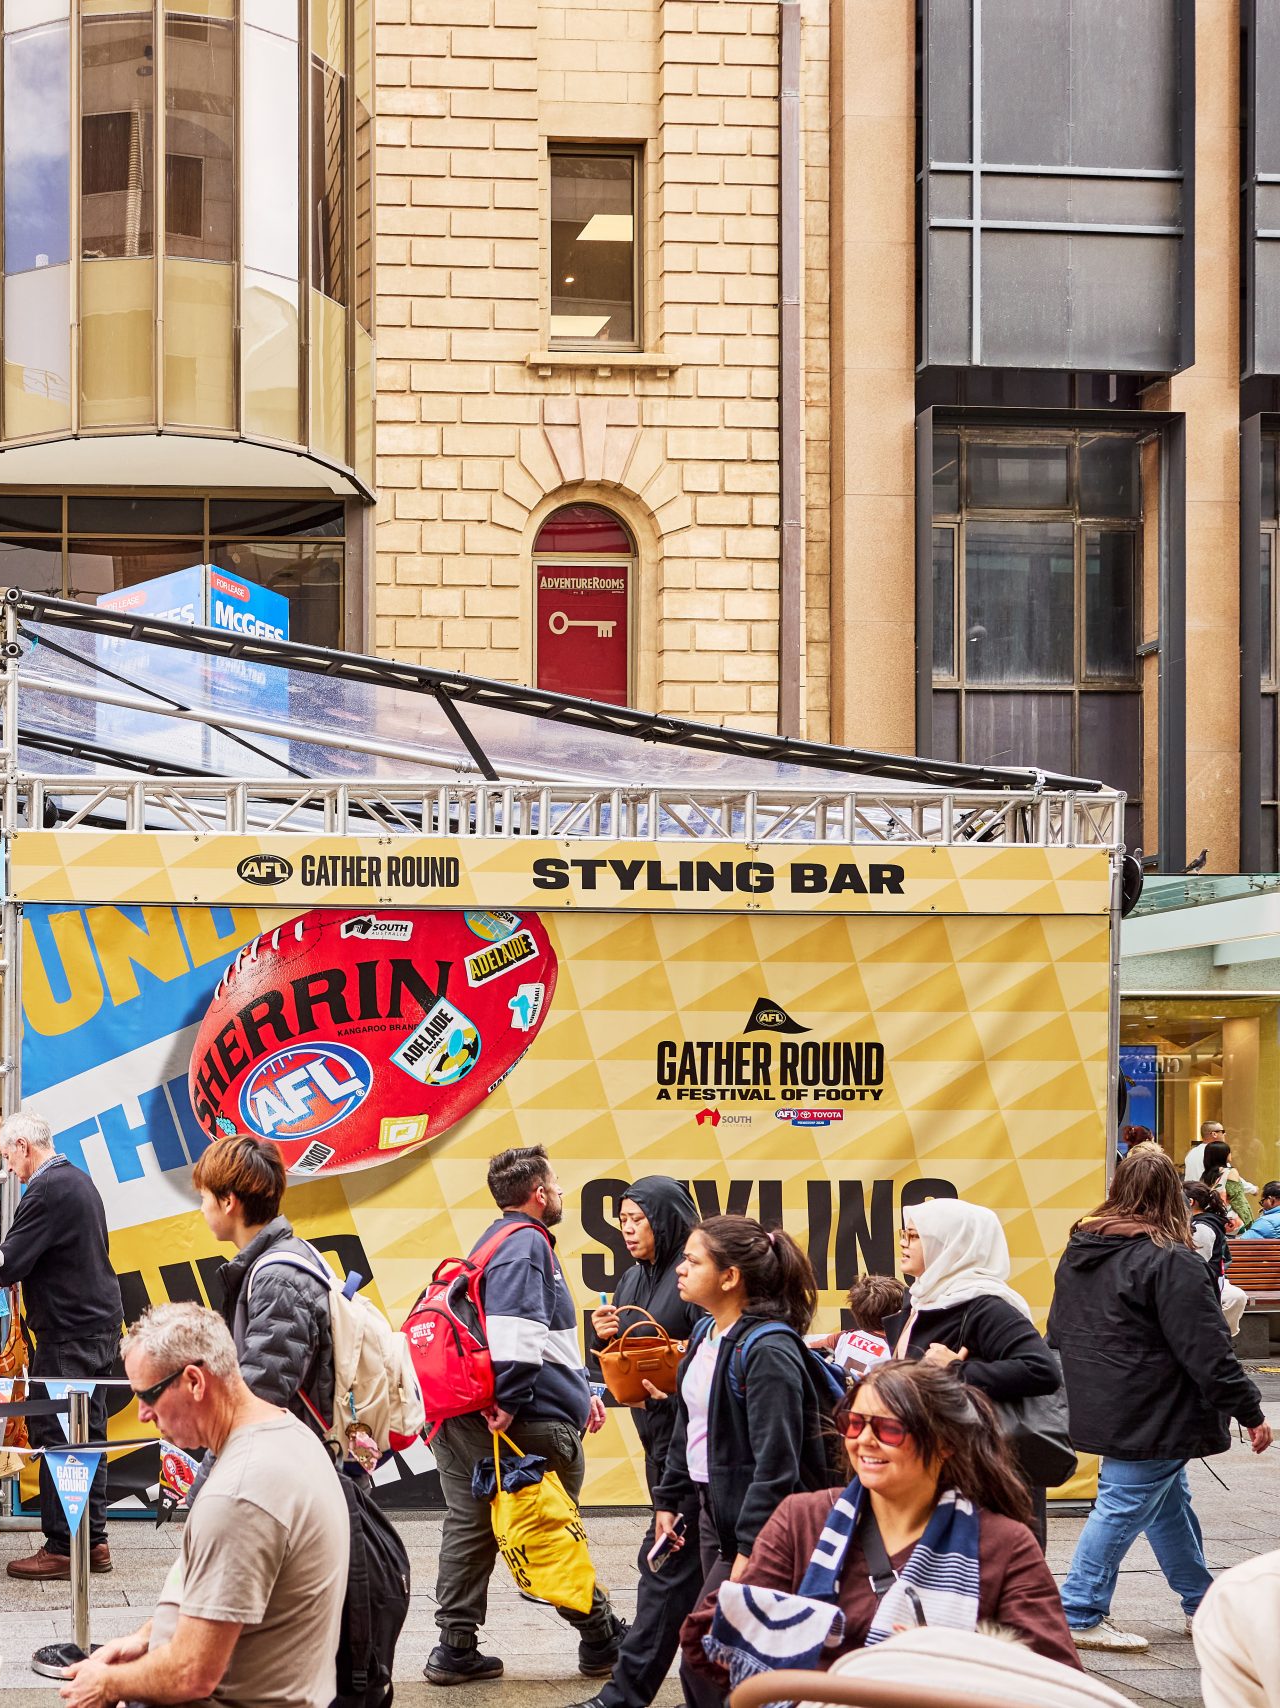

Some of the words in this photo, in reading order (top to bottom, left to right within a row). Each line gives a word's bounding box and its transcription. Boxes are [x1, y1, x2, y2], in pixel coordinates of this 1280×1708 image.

[216, 578, 228, 590] FOR
[228, 582, 245, 597] LEASE
[240, 861, 290, 880] AFL
[301, 854, 382, 888] GATHER
[387, 855, 460, 888] ROUND
[532, 858, 775, 894] STYLING
[791, 862, 906, 895] BAR
[373, 922, 410, 933] SOUTH
[470, 934, 531, 980] ADELAIDE
[760, 1013, 785, 1023] AFL
[337, 1024, 387, 1037] KANGAROO
[402, 1008, 454, 1066] ADELAIDE
[194, 958, 456, 1136] SHERRIN
[427, 1036, 445, 1054] OVAL
[656, 1040, 772, 1086] GATHER
[780, 1041, 885, 1087] ROUND
[250, 1056, 367, 1136] AFL
[656, 1089, 671, 1100] A
[676, 1088, 776, 1101] FESTIVAL
[781, 1088, 809, 1101] OF
[813, 1088, 884, 1101] FOOTY
[722, 1115, 752, 1124] SOUTH
[776, 1110, 797, 1119] AFL
[410, 1321, 436, 1333] CHICAGO
[412, 1329, 432, 1338] BULLS
[850, 1335, 879, 1353] KFC
[56, 1465, 89, 1481] GATHER
[58, 1478, 88, 1493] ROUND
